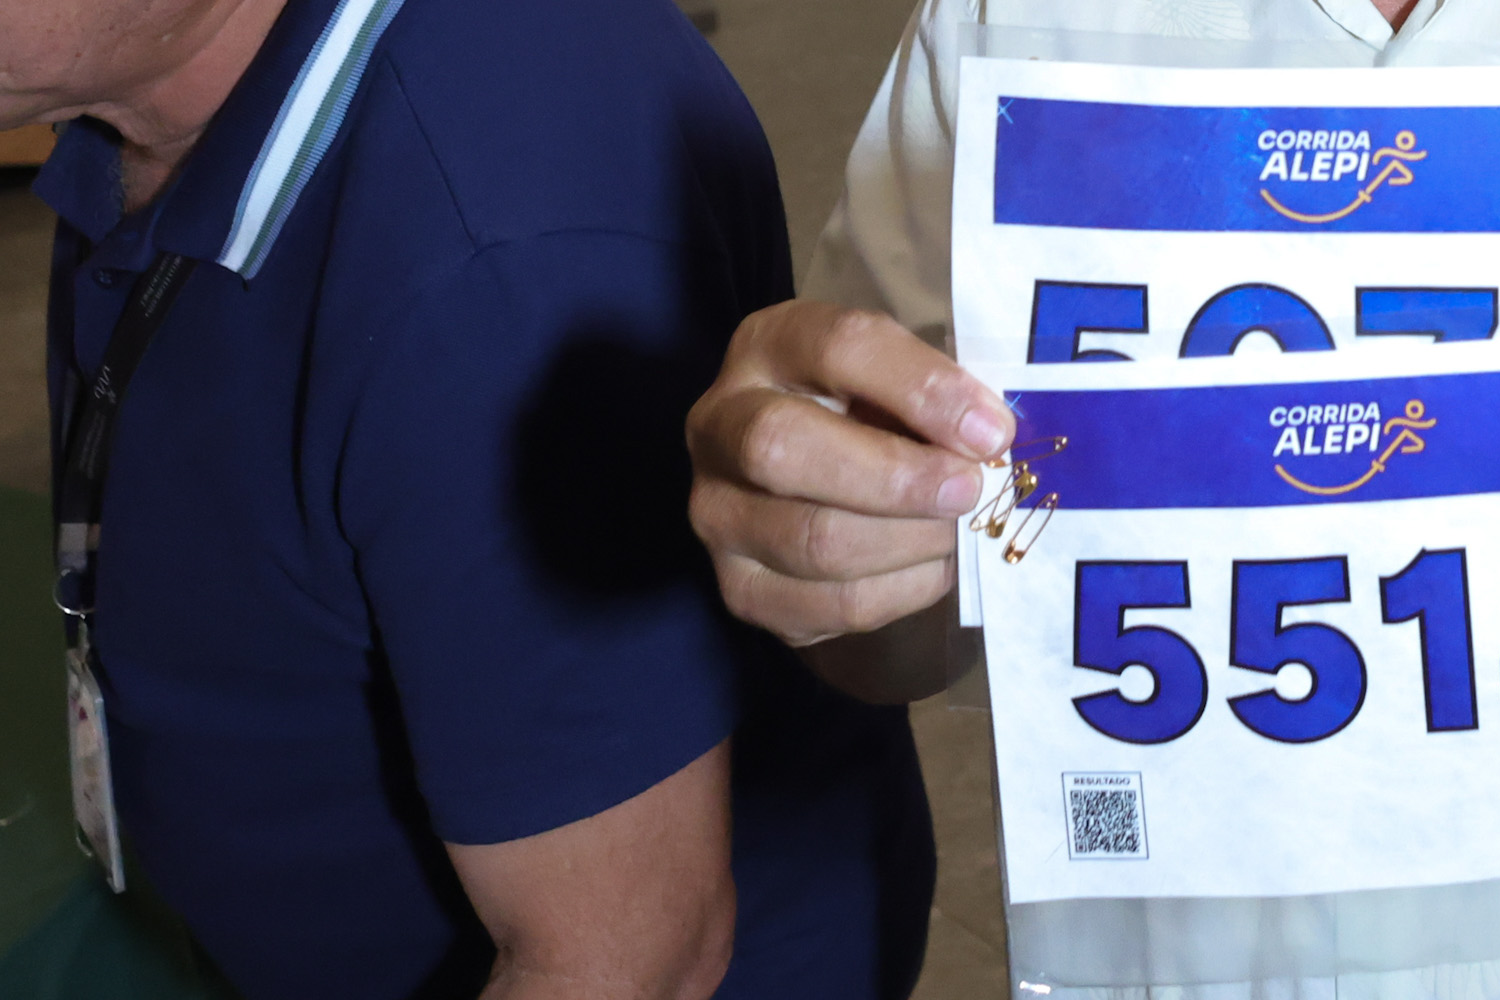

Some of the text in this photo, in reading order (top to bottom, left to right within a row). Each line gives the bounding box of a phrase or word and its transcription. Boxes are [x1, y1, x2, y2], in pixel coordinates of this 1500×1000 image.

[1257, 129, 1371, 151] CORRIDA
[1258, 150, 1371, 182] ALEPI
[1269, 401, 1381, 427] CORRIDA
[1272, 421, 1381, 457] ALEPI
[1074, 776, 1131, 786] RESULTADO
